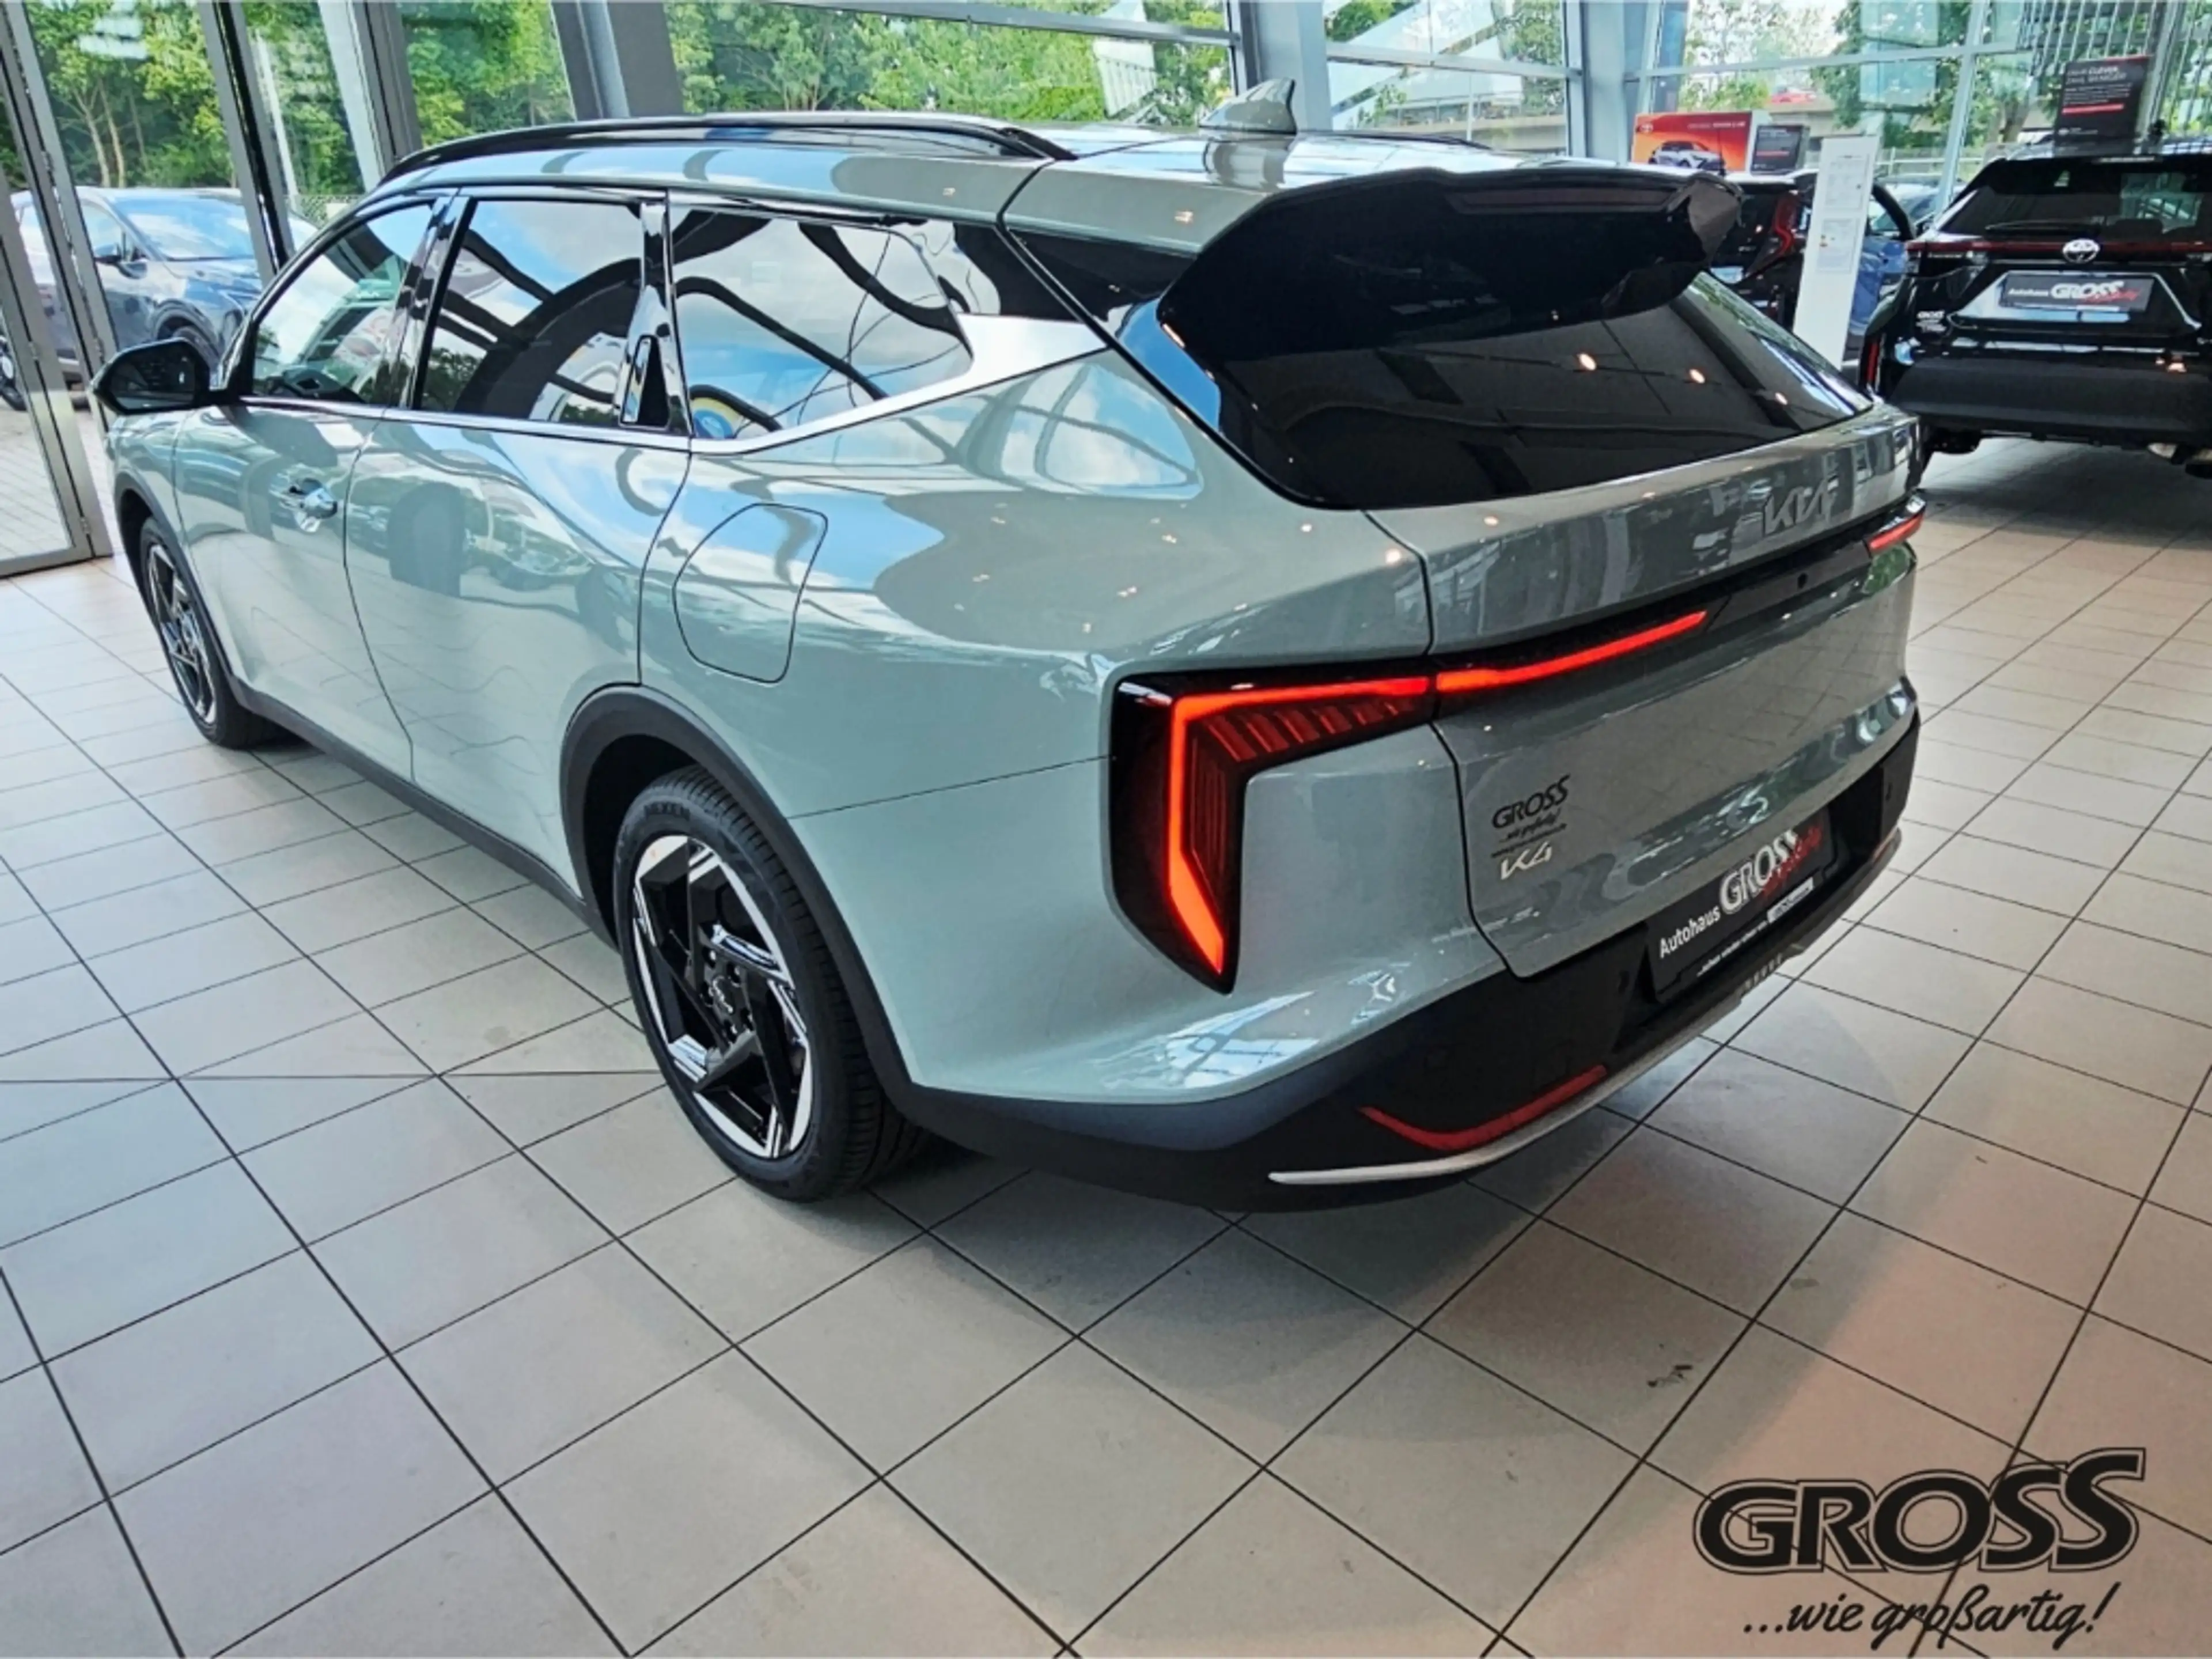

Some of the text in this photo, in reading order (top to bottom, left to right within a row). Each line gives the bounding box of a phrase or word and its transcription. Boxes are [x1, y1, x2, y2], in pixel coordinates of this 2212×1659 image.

[2051, 281, 2124, 300] GROSS
[1764, 480, 1837, 536] KIA
[1492, 773, 1570, 829] GROSS
[1500, 840, 1553, 880] K4
[1658, 904, 1721, 959] Autohaus
